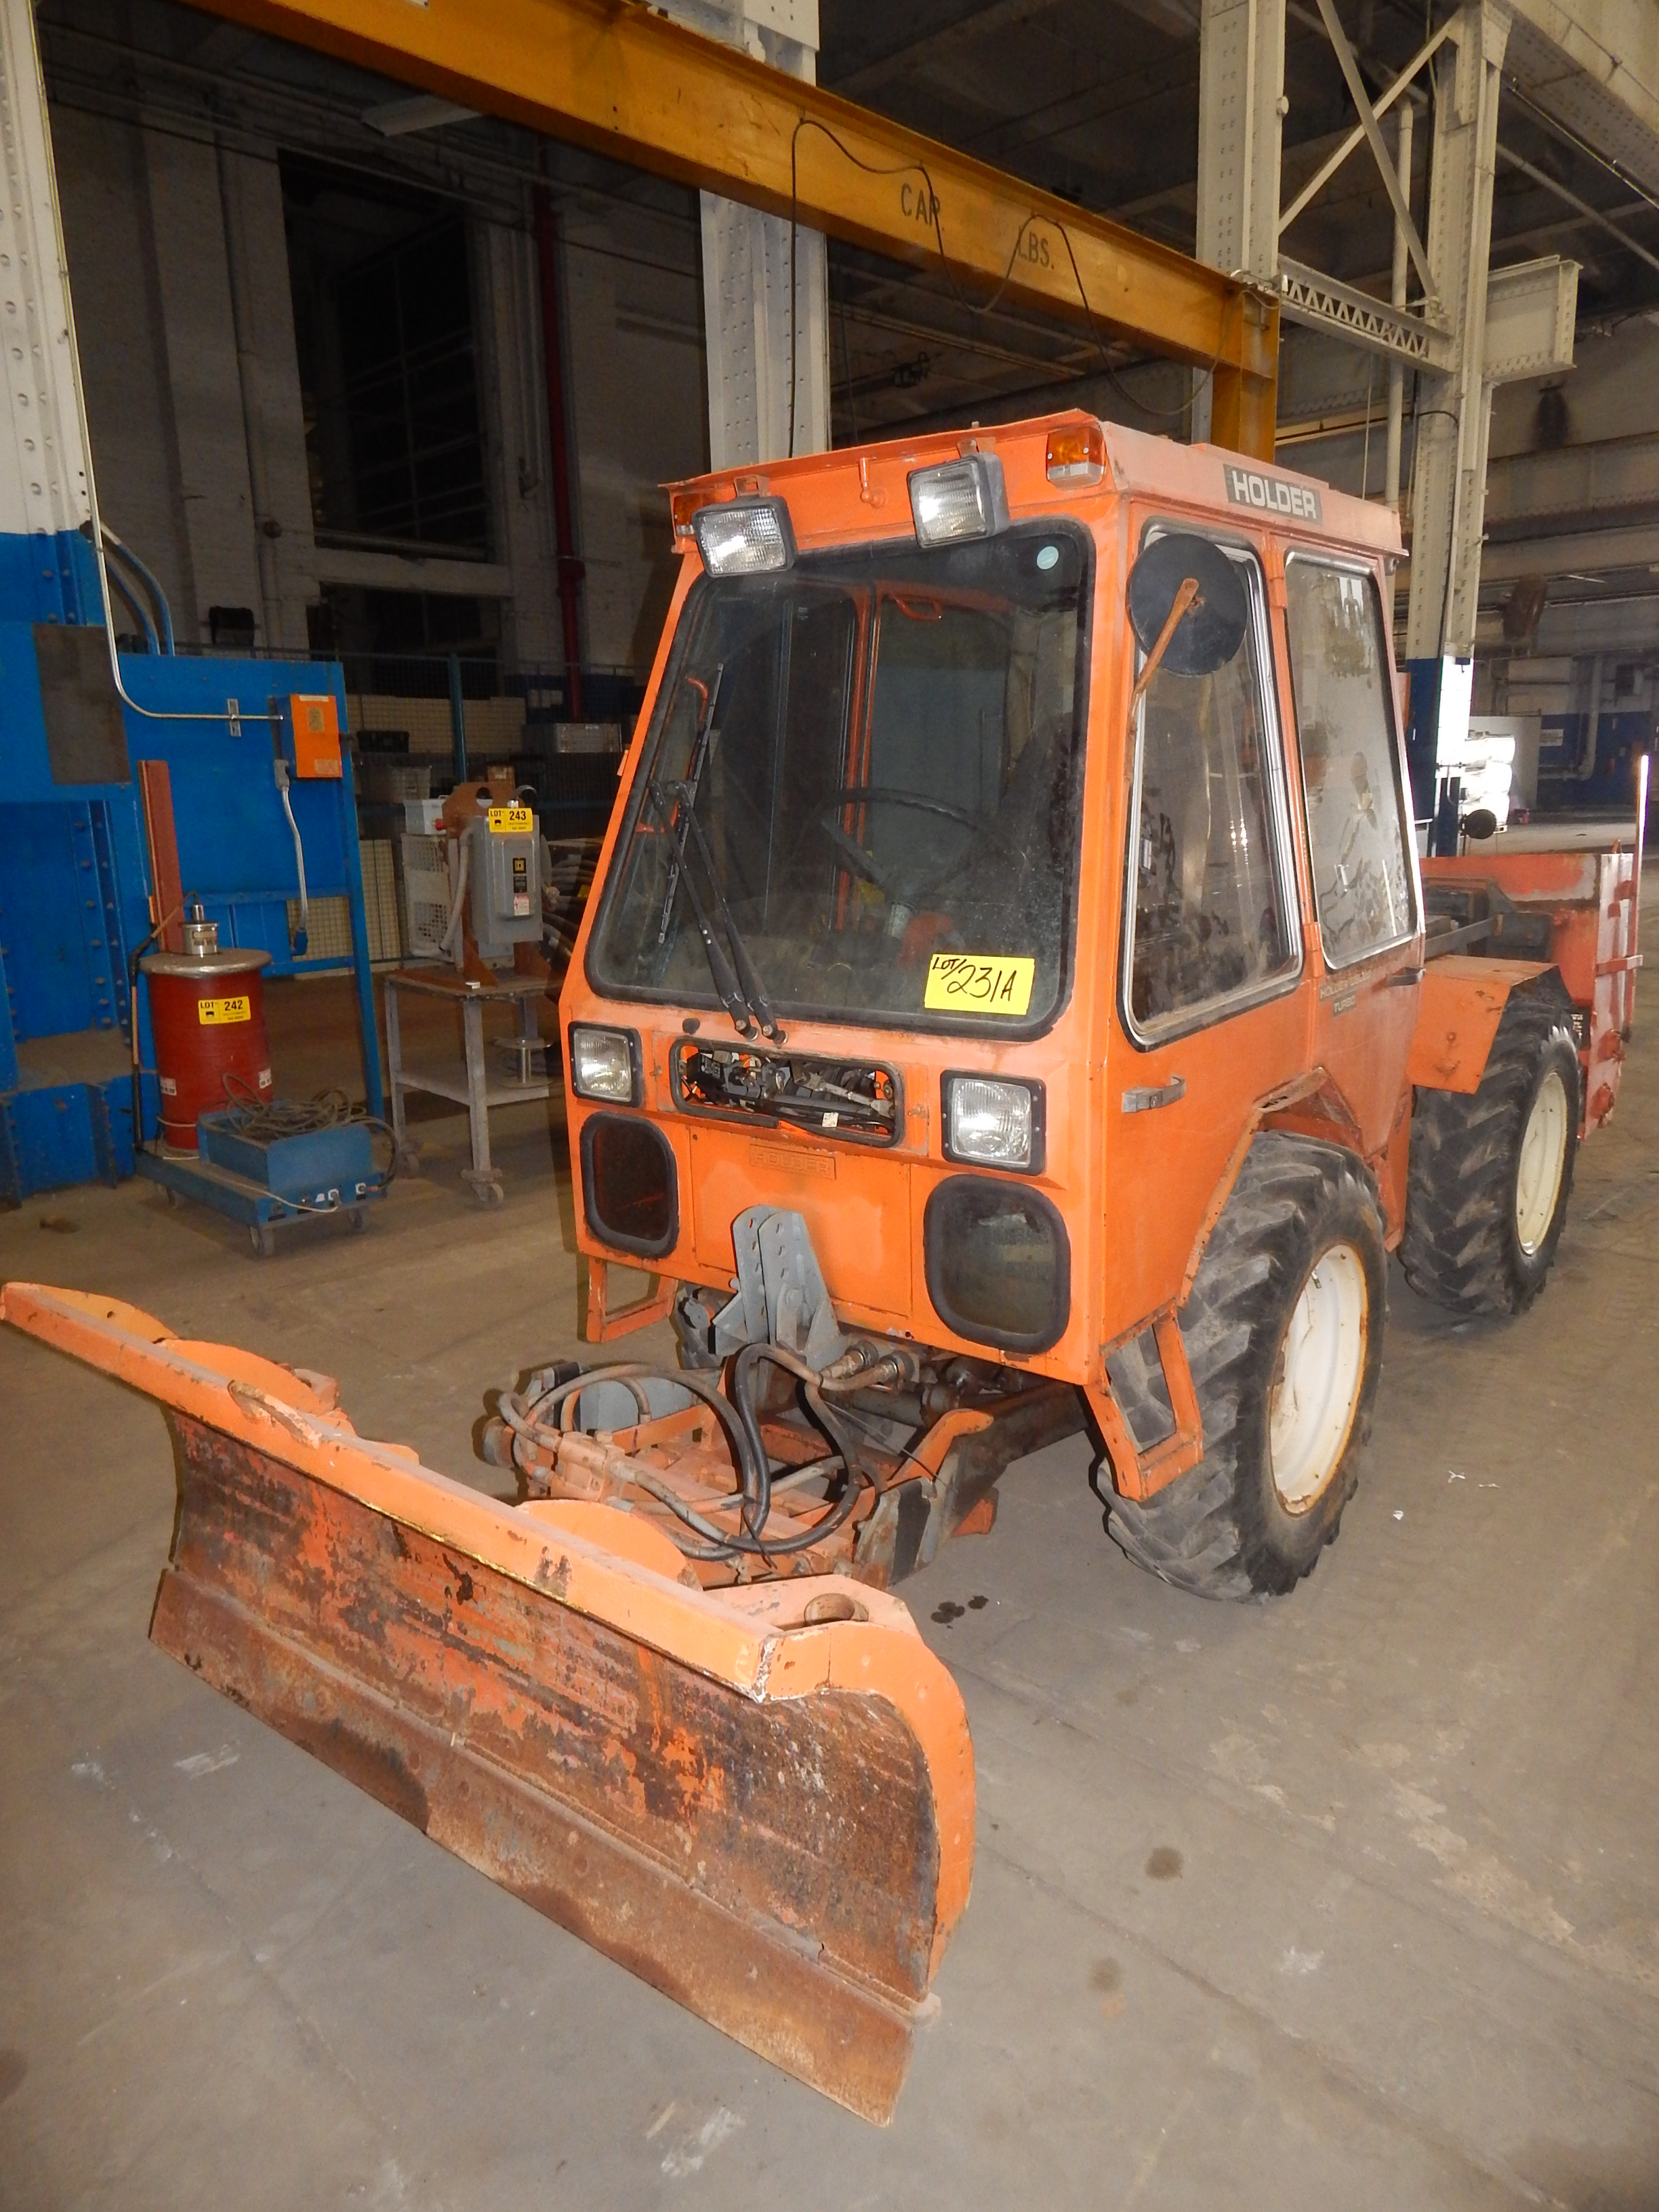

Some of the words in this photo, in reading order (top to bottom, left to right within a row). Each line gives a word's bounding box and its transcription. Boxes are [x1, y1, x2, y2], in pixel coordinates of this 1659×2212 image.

[1231, 470, 1317, 520] HOLDER
[509, 810, 527, 821] 243
[200, 1001, 214, 1009] LOT
[224, 1000, 243, 1011] 242
[1333, 994, 1356, 1013] TURBO
[754, 1149, 832, 1174] HOLDER
